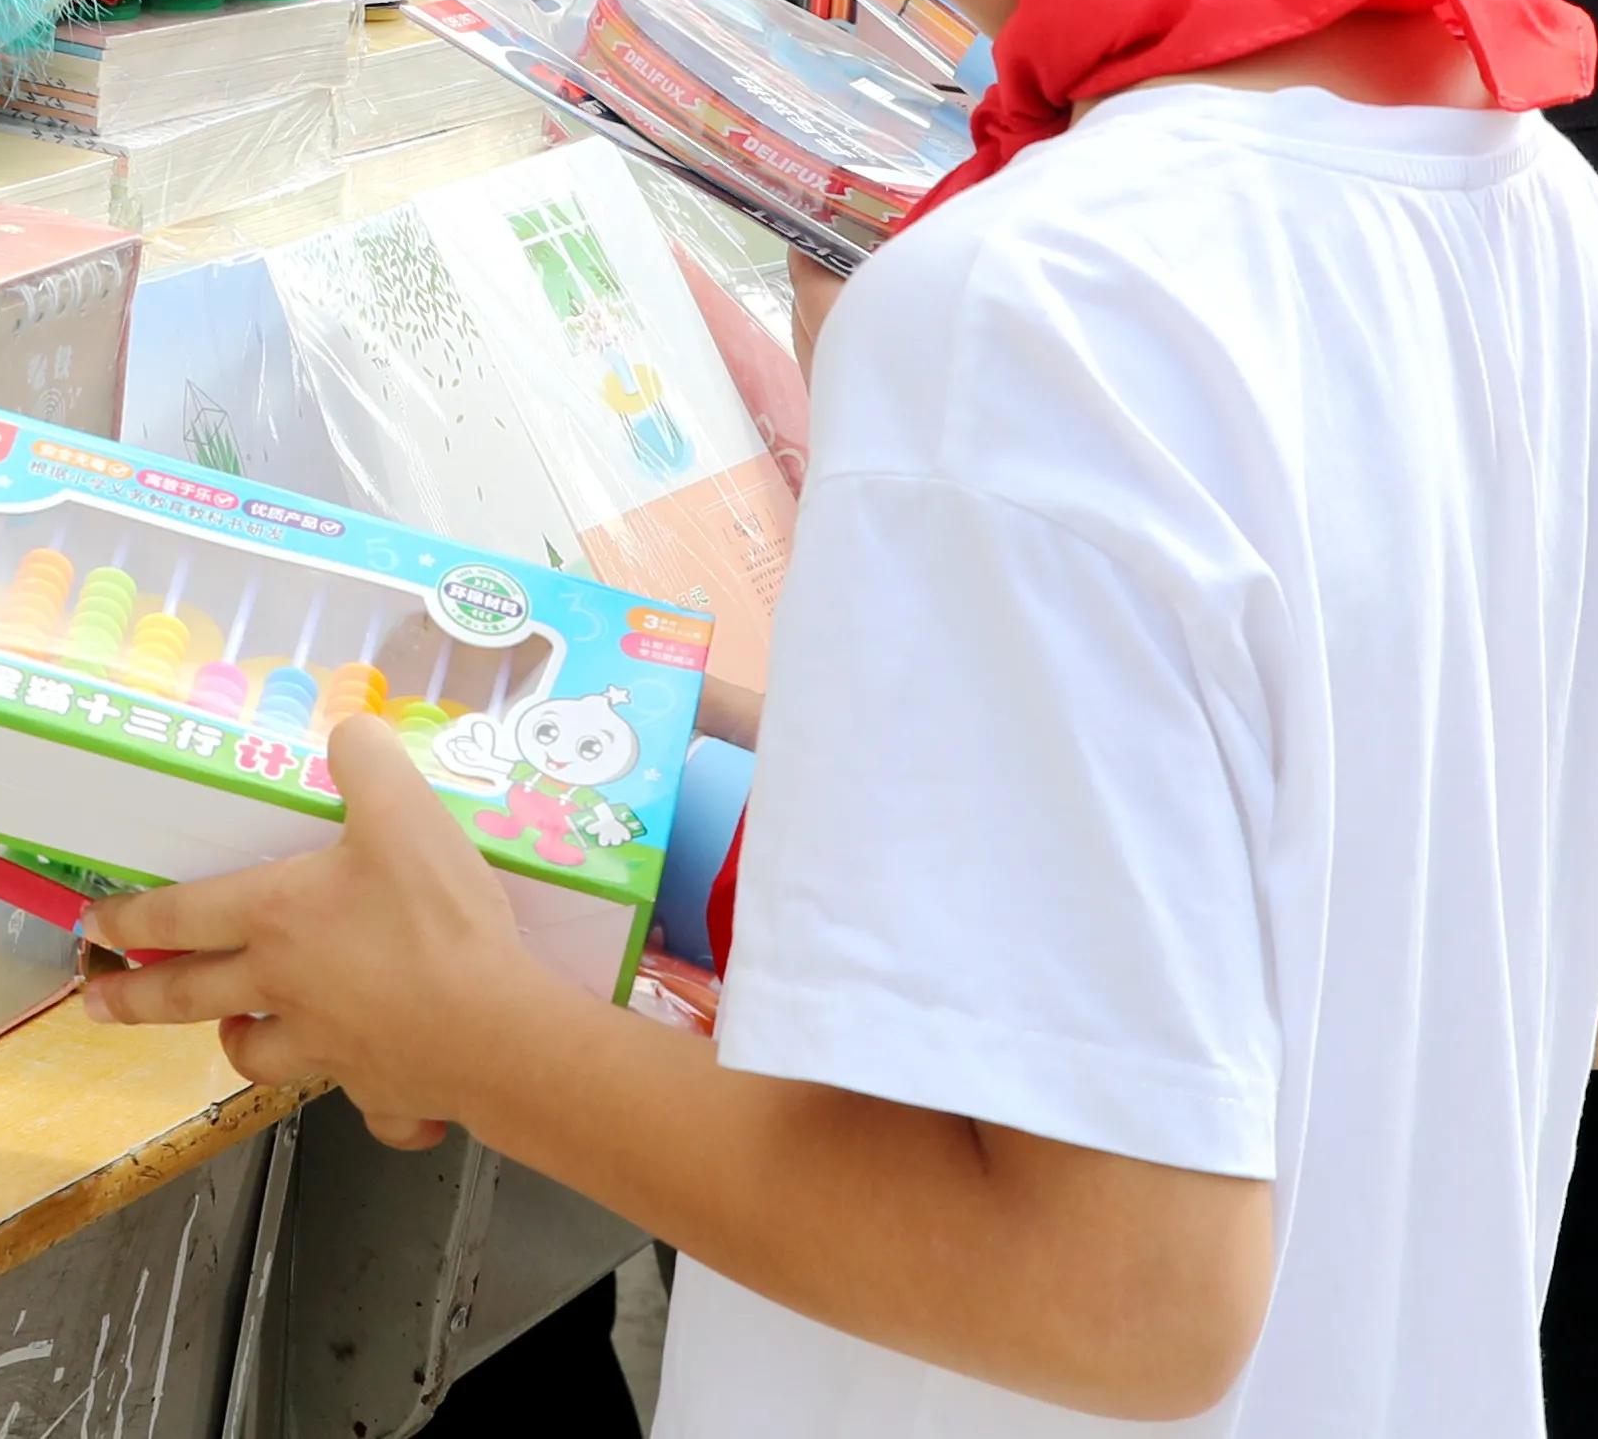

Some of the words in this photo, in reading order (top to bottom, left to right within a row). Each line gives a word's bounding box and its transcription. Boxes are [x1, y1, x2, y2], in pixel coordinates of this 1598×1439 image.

[623, 49, 686, 106] DELIFUX
[741, 135, 833, 194] DELIFUX
[251, 501, 319, 530] 优质产品
